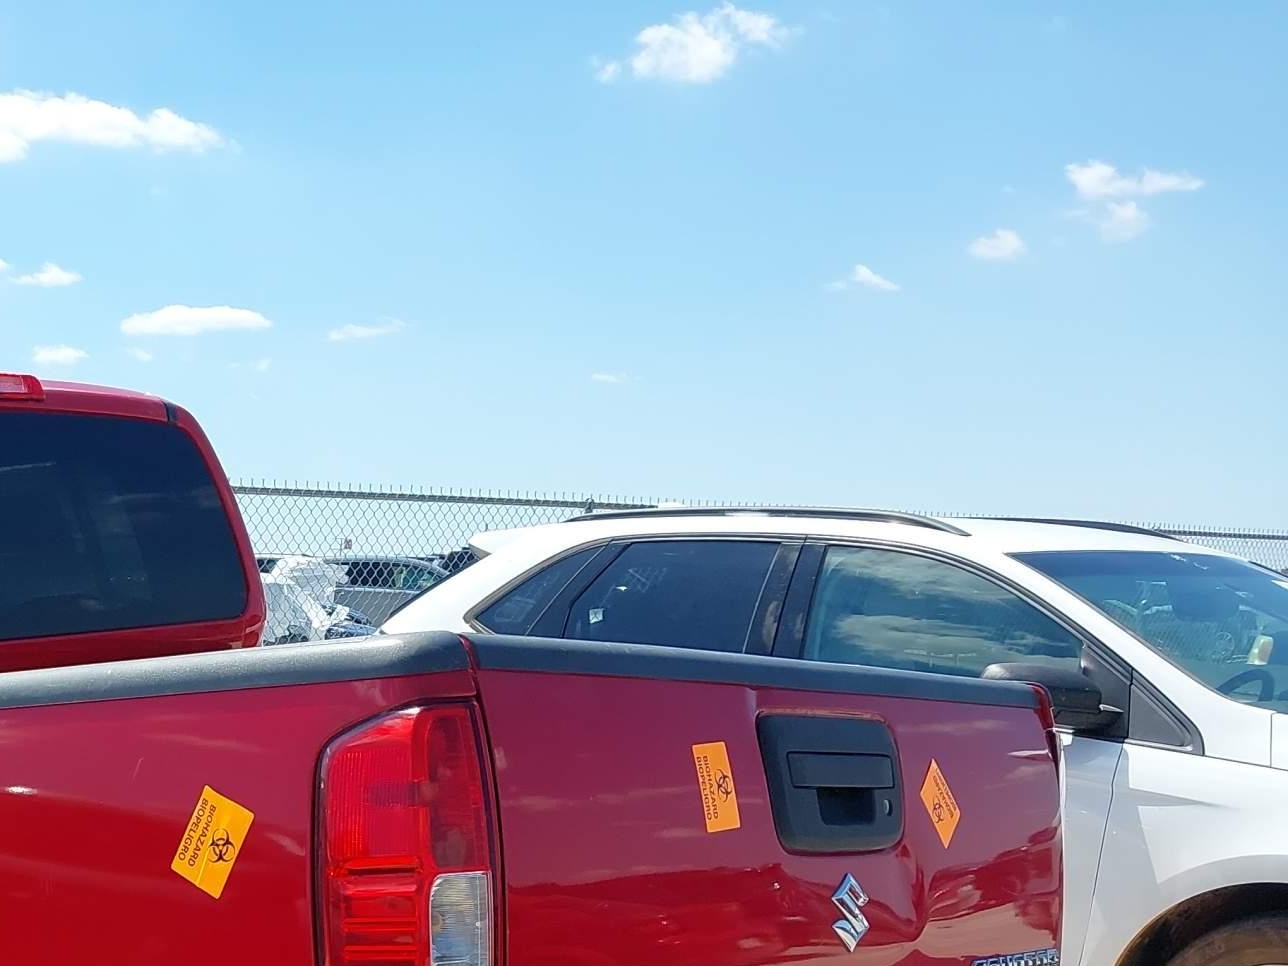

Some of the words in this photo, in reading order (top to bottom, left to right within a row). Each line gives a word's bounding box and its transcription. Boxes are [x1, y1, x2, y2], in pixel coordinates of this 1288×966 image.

[696, 756, 713, 821] BIOPELIGRO
[702, 755, 719, 819] BIOHAZARD
[178, 797, 209, 861] BIOPELIGRO
[187, 804, 217, 867] BIOHAZARD
